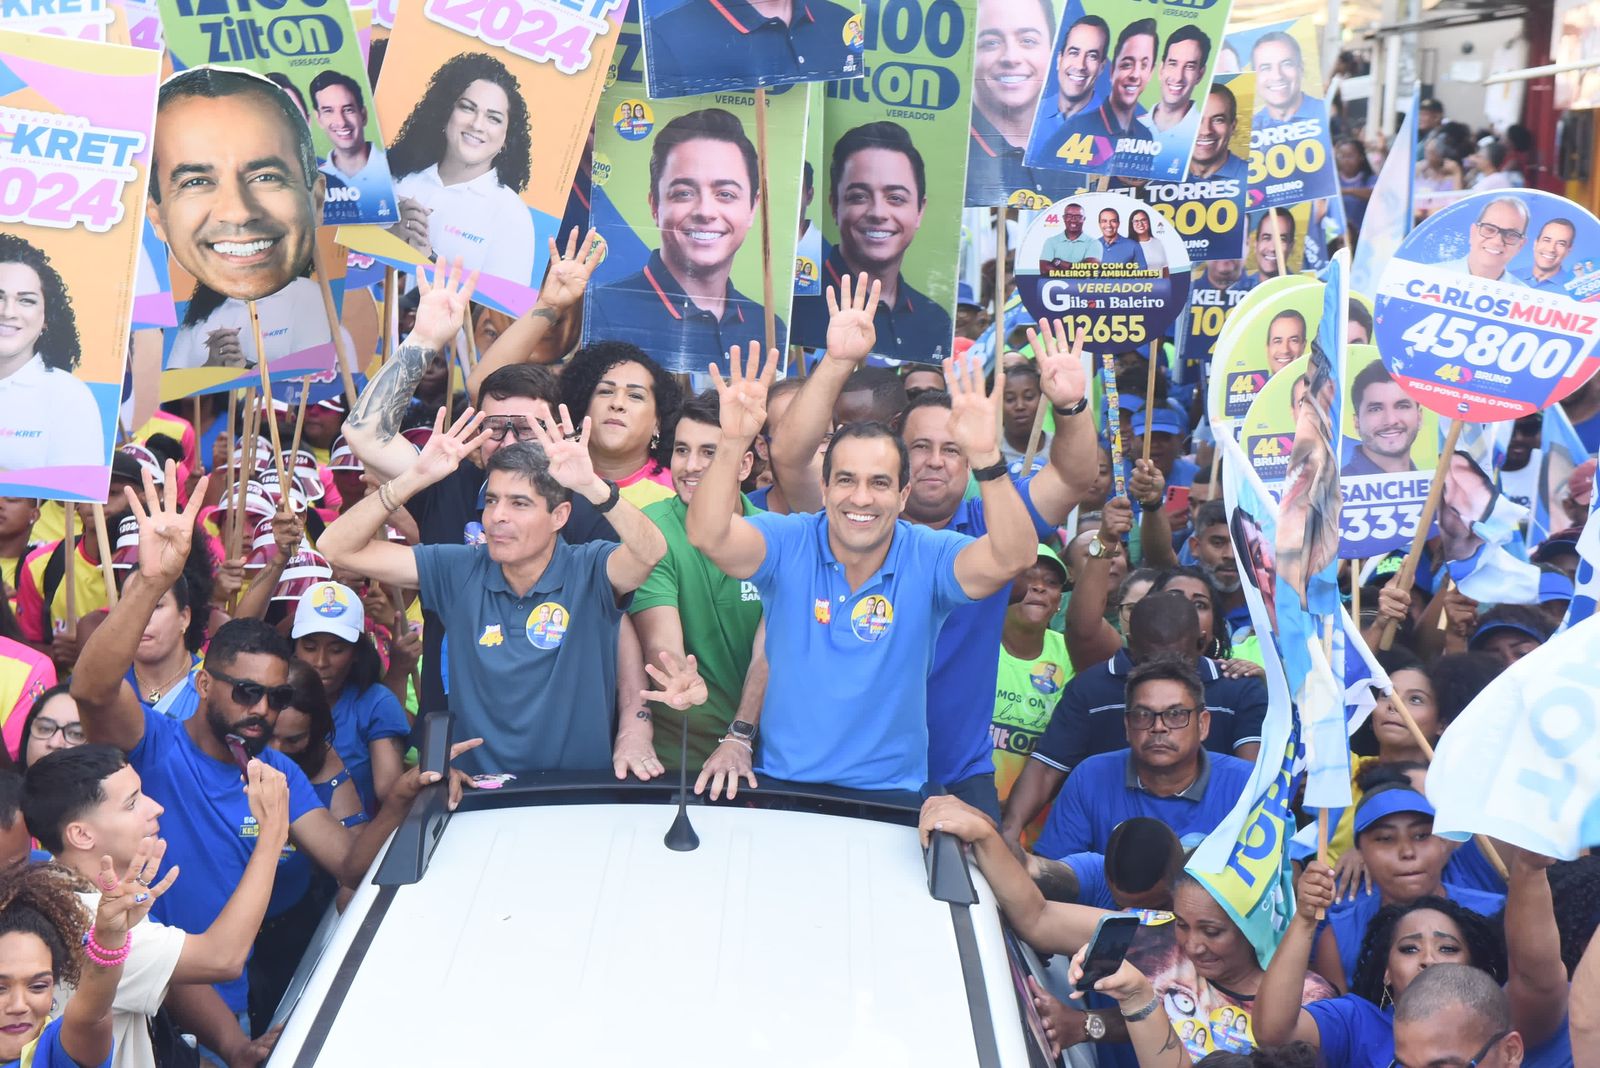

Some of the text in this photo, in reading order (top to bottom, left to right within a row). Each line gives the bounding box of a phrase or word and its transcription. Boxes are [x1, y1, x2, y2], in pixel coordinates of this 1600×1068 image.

[200, 15, 341, 62] Zilton
[715, 94, 770, 108] VEREADR
[886, 108, 936, 121] VEREADOR
[1056, 133, 1093, 166] 44
[1115, 138, 1162, 156] BRUNO
[325, 186, 361, 203] UNO
[1144, 179, 1241, 203] TORRES
[1049, 270, 1092, 278] BALEIROS
[1101, 269, 1160, 277] AMBULANTES
[1070, 262, 1140, 271] JUNTO COM OS
[1077, 282, 1154, 294] VEREADOR
[1191, 289, 1226, 306] KEL
[1109, 296, 1165, 309] Baleiro
[1062, 314, 1146, 343] 12655
[1402, 312, 1572, 379] 45800
[1230, 374, 1255, 394] 44
[1434, 363, 1512, 385] 44 BRUNO
[1408, 380, 1433, 391] PELO
[1462, 393, 1487, 404] PARA
[1487, 398, 1496, 406] O
[1253, 437, 1281, 457] 44
[1340, 477, 1434, 502] SANCHE
